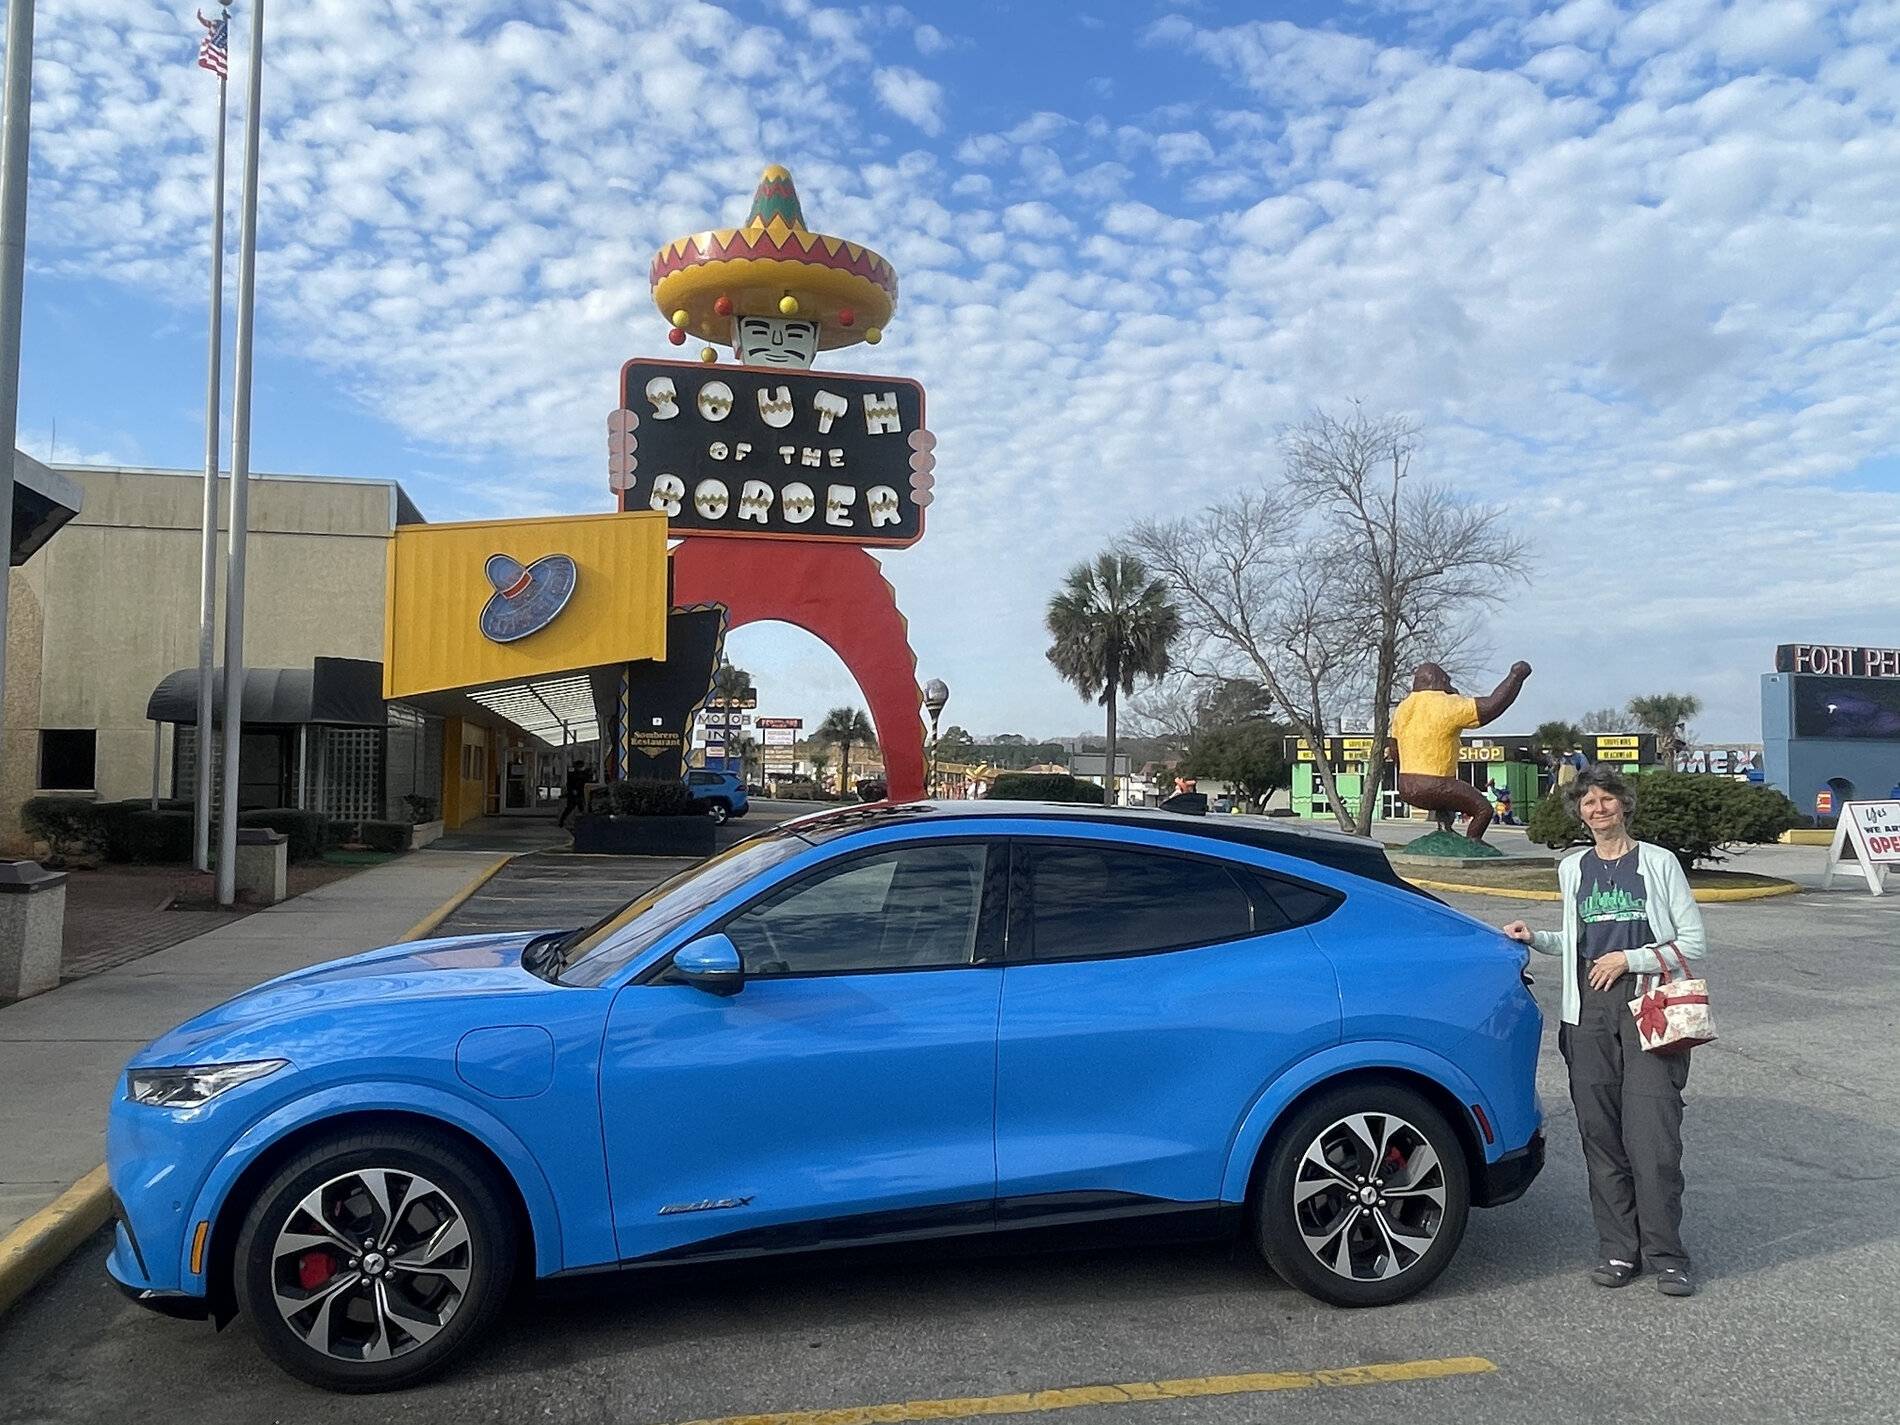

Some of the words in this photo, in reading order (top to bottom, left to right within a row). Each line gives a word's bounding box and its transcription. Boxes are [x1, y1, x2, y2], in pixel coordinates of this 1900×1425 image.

[645, 376, 902, 435] SOUTH
[709, 441, 752, 461] OF
[779, 445, 845, 468] THE
[649, 473, 902, 528] BORDER
[1794, 645, 1857, 676] FORT
[630, 738, 681, 746] Restaurant
[633, 730, 678, 739] Sombrero
[1458, 747, 1501, 760] SHOP
[1863, 826, 1881, 834] WE
[1869, 836, 1900, 854] OPE
